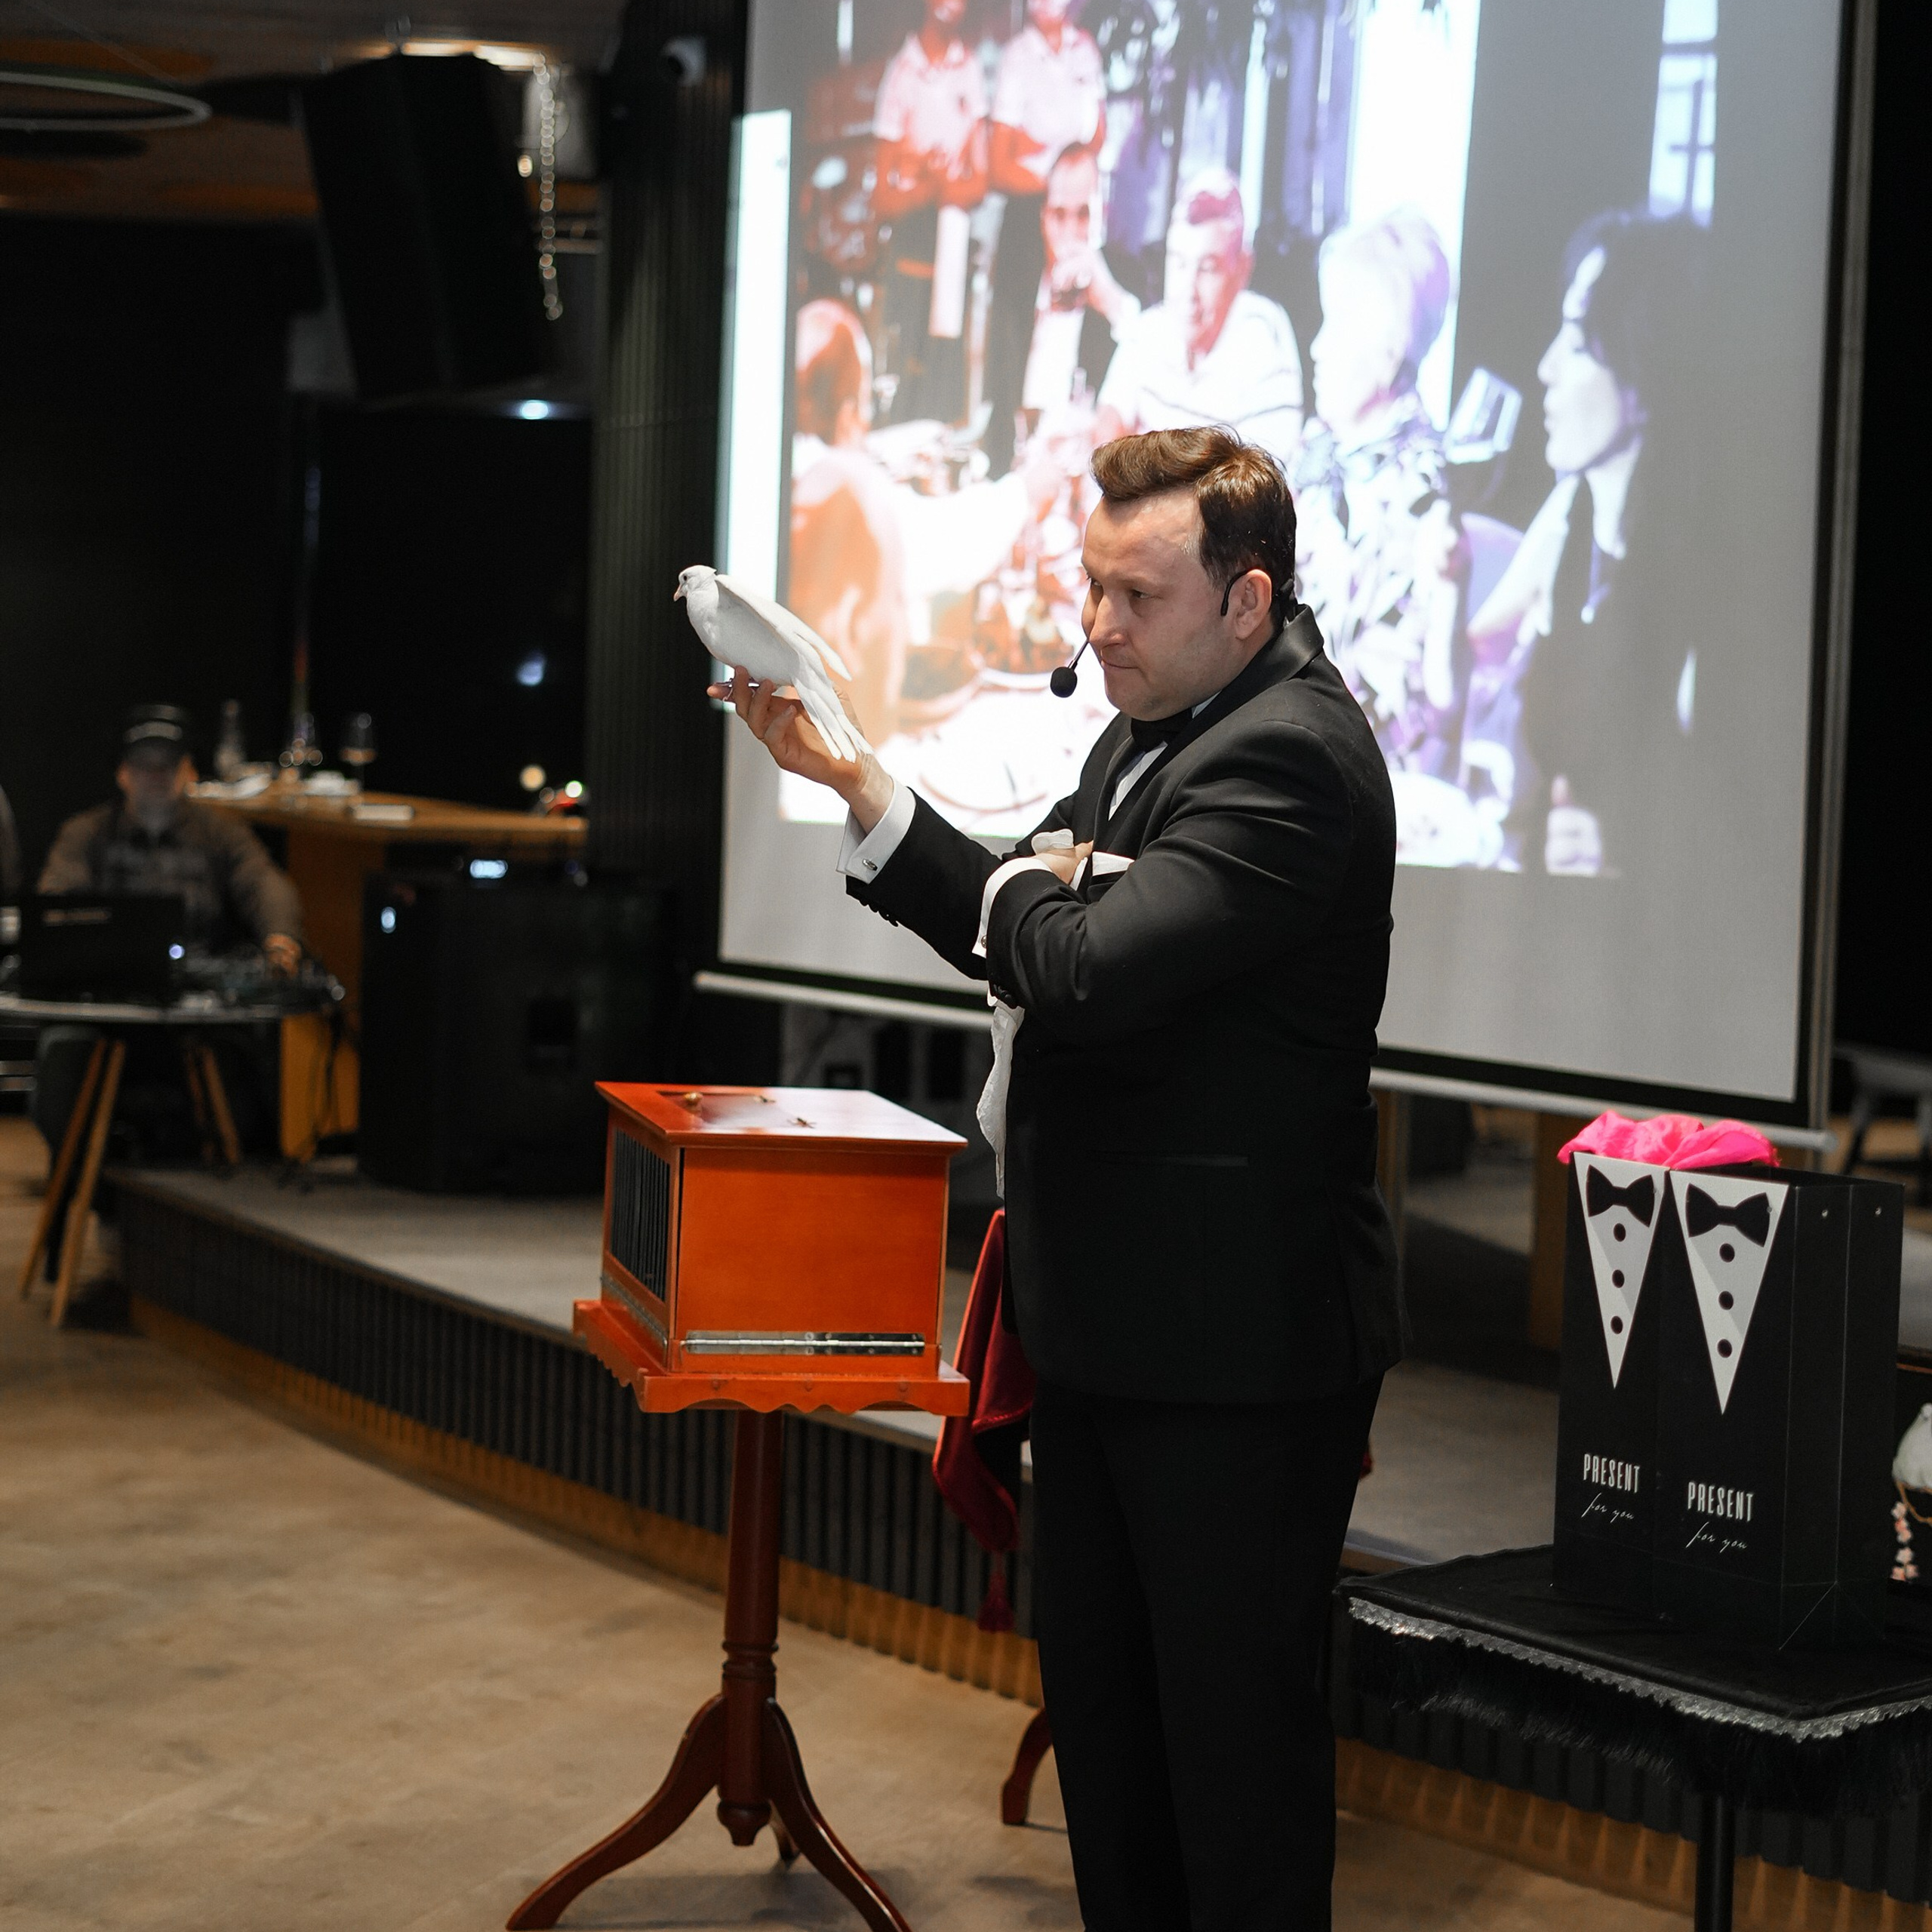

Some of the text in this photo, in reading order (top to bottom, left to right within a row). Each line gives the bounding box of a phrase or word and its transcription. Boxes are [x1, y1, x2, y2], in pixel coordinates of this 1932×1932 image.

[1583, 1454, 1640, 1494] PRESENT
[1581, 1492, 1635, 1523] for you
[1687, 1481, 1754, 1521] PRESENT
[1686, 1521, 1747, 1553] for you
